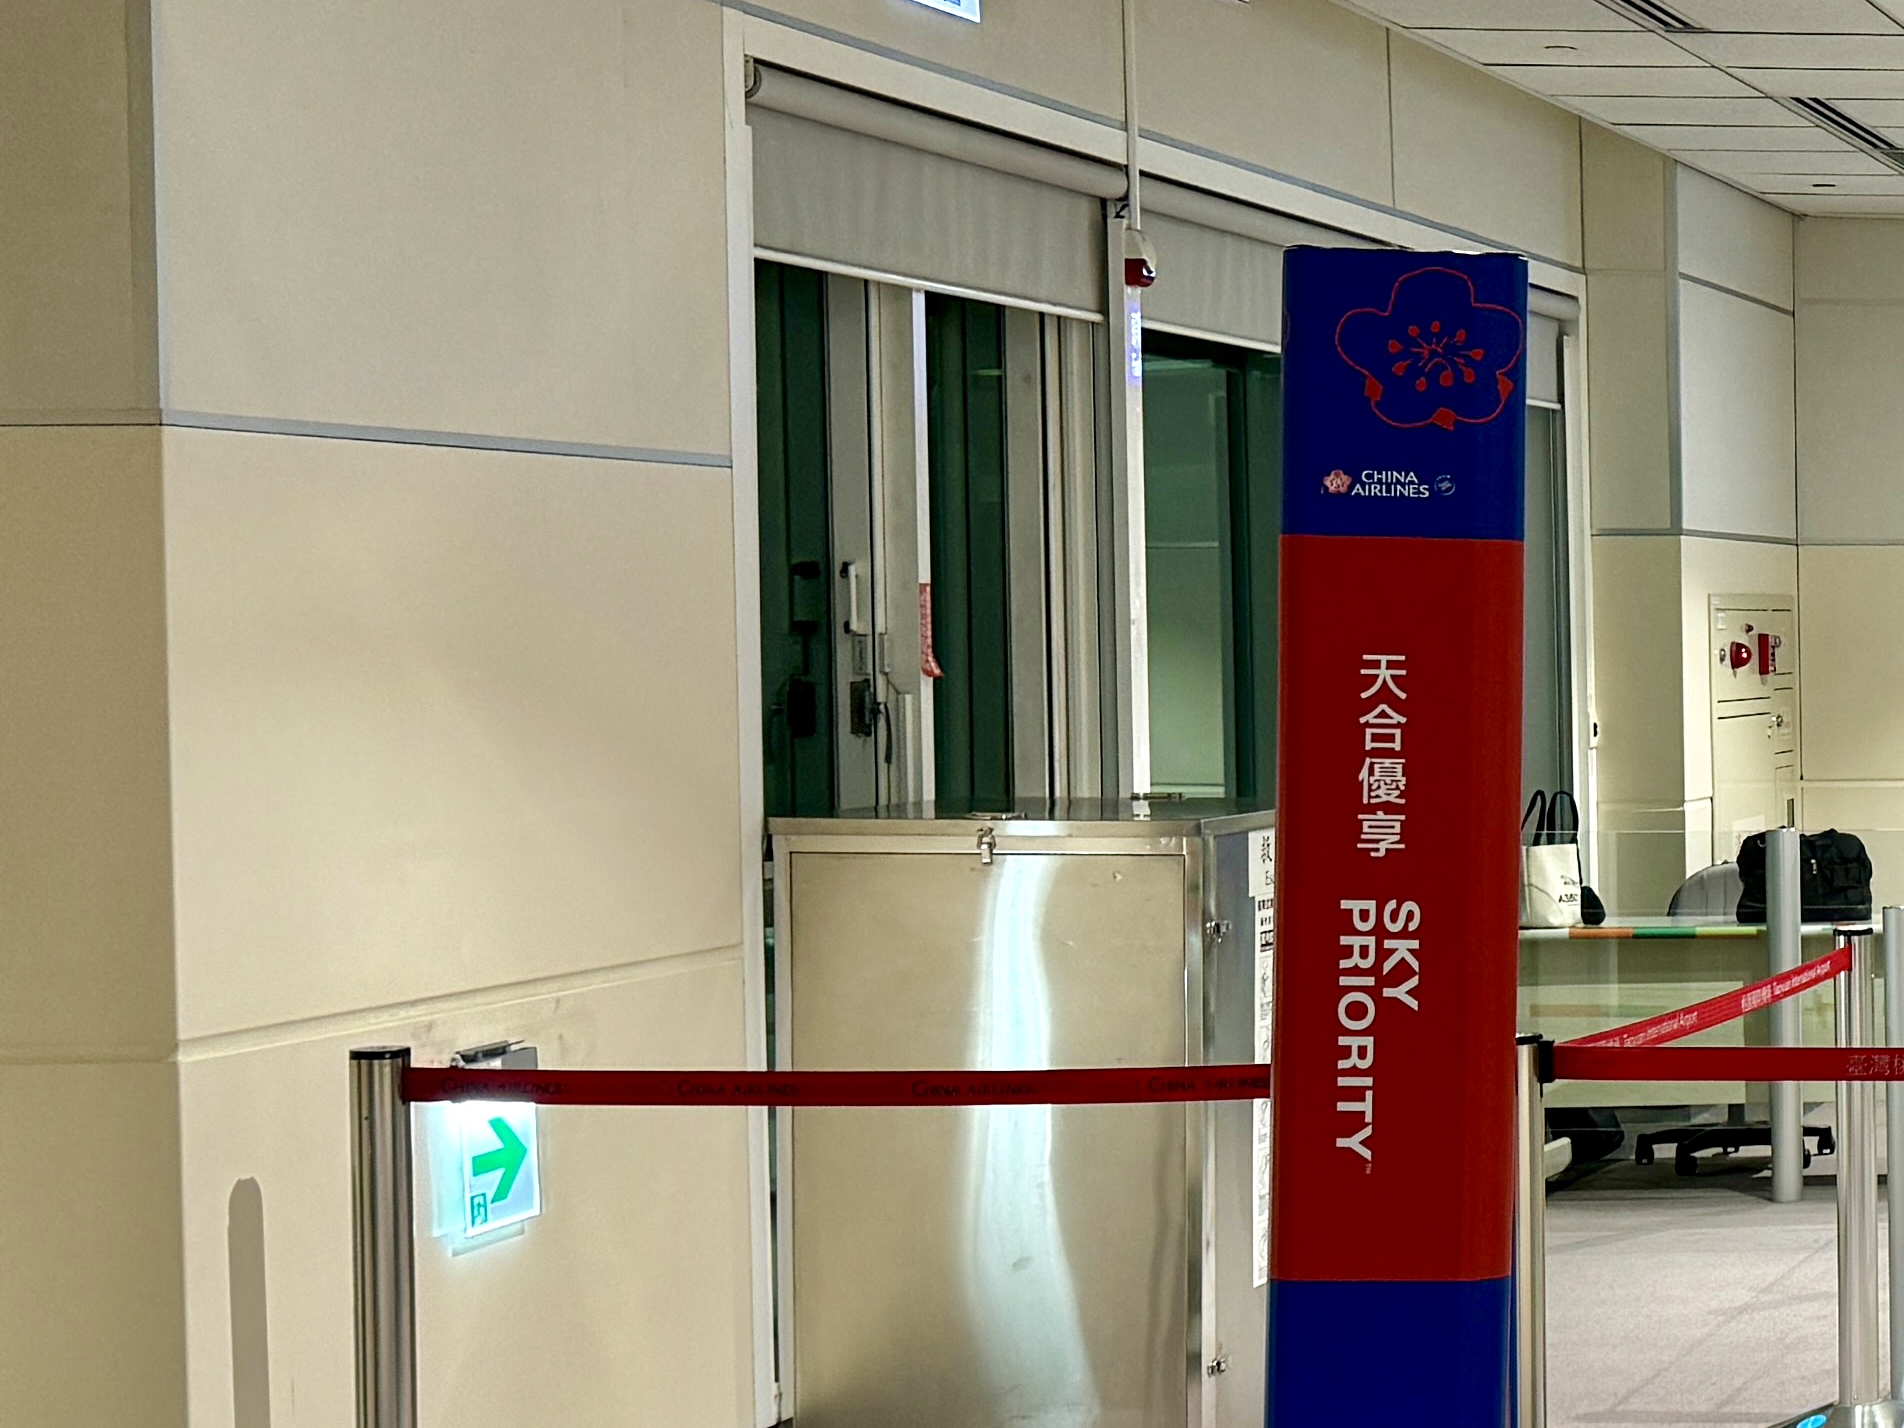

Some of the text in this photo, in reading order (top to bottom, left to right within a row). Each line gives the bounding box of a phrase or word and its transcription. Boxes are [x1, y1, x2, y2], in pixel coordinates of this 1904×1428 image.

[1351, 483, 1430, 498] AIRLINES
[1361, 470, 1419, 483] CHINA
[1356, 654, 1408, 857] 天合優享
[1382, 899, 1421, 1011] SKY
[1336, 899, 1377, 1161] PRIORITY
